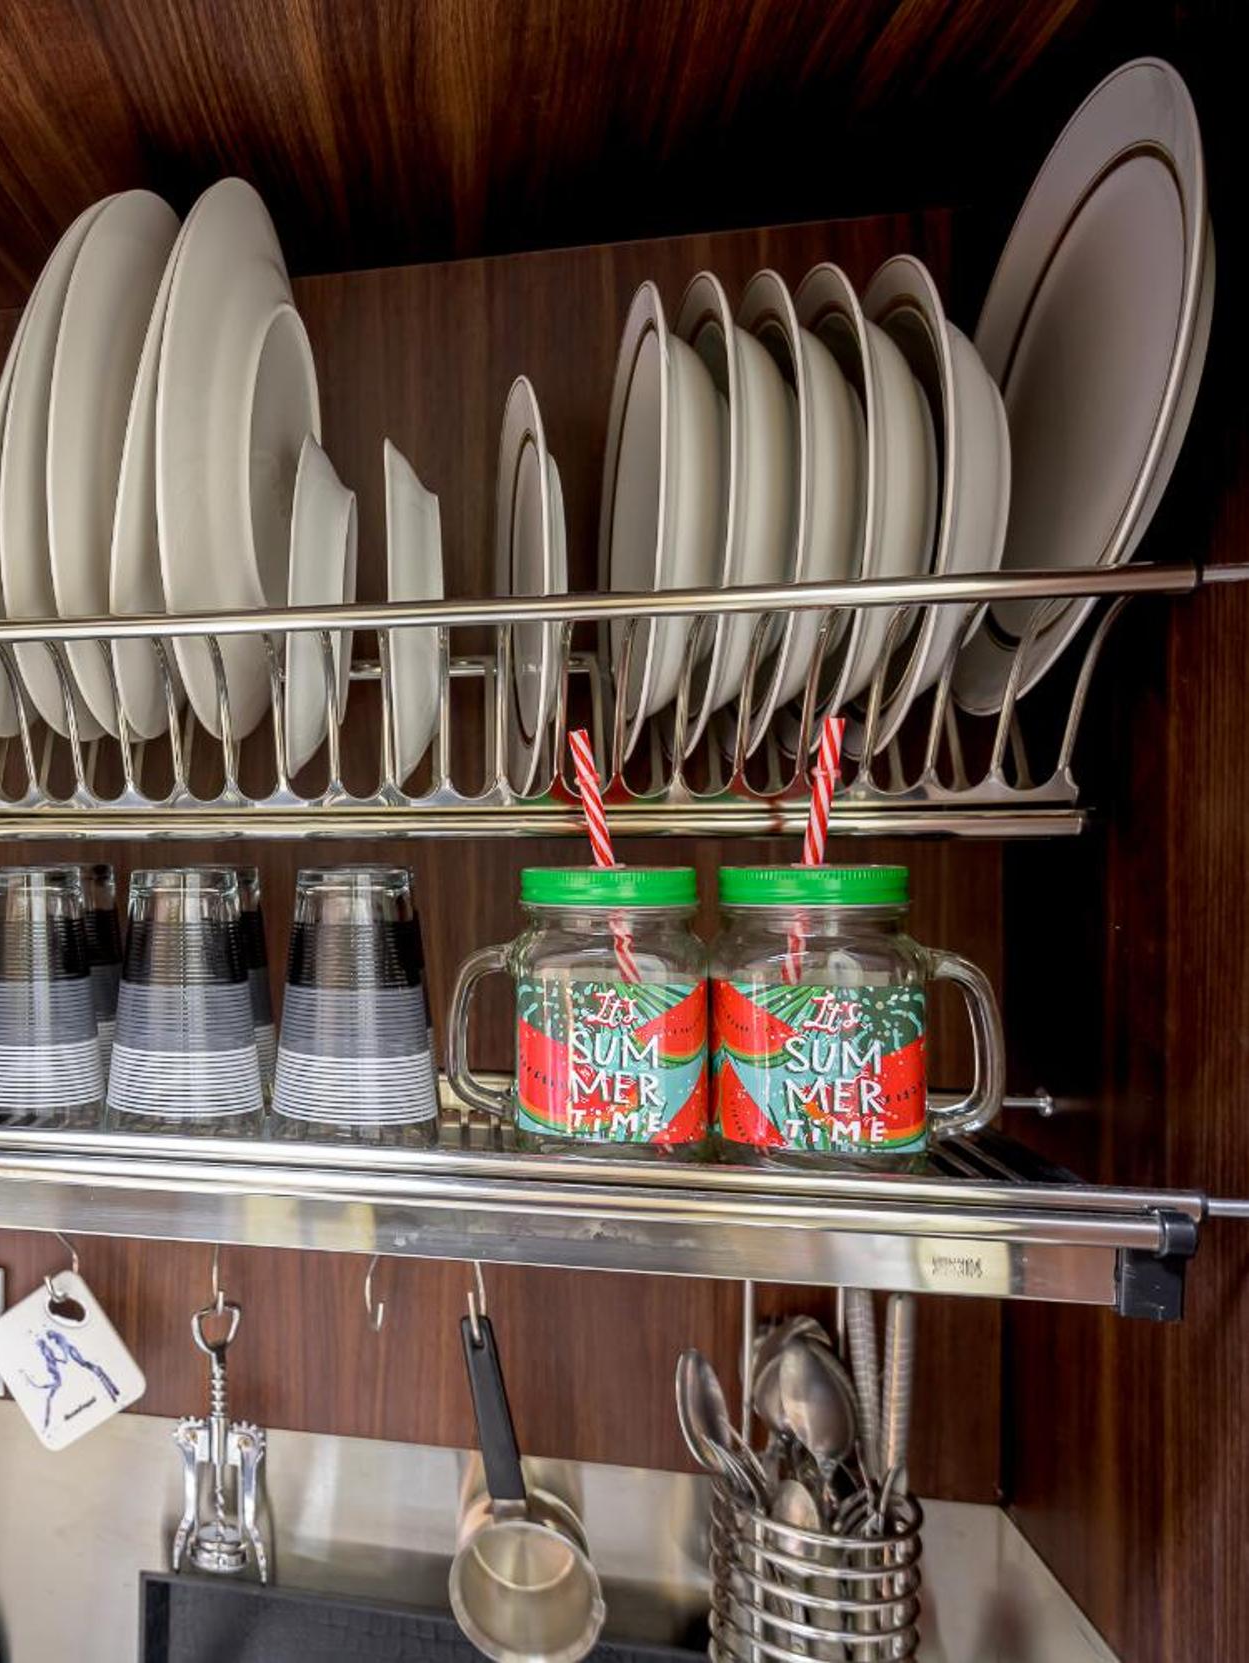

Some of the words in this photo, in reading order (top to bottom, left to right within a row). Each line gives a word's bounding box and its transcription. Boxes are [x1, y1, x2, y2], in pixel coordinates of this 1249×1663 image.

[569, 1030, 659, 1068] SUM
[785, 1036, 882, 1075] SUM
[569, 1069, 667, 1107] MER
[784, 1075, 886, 1113] MER
